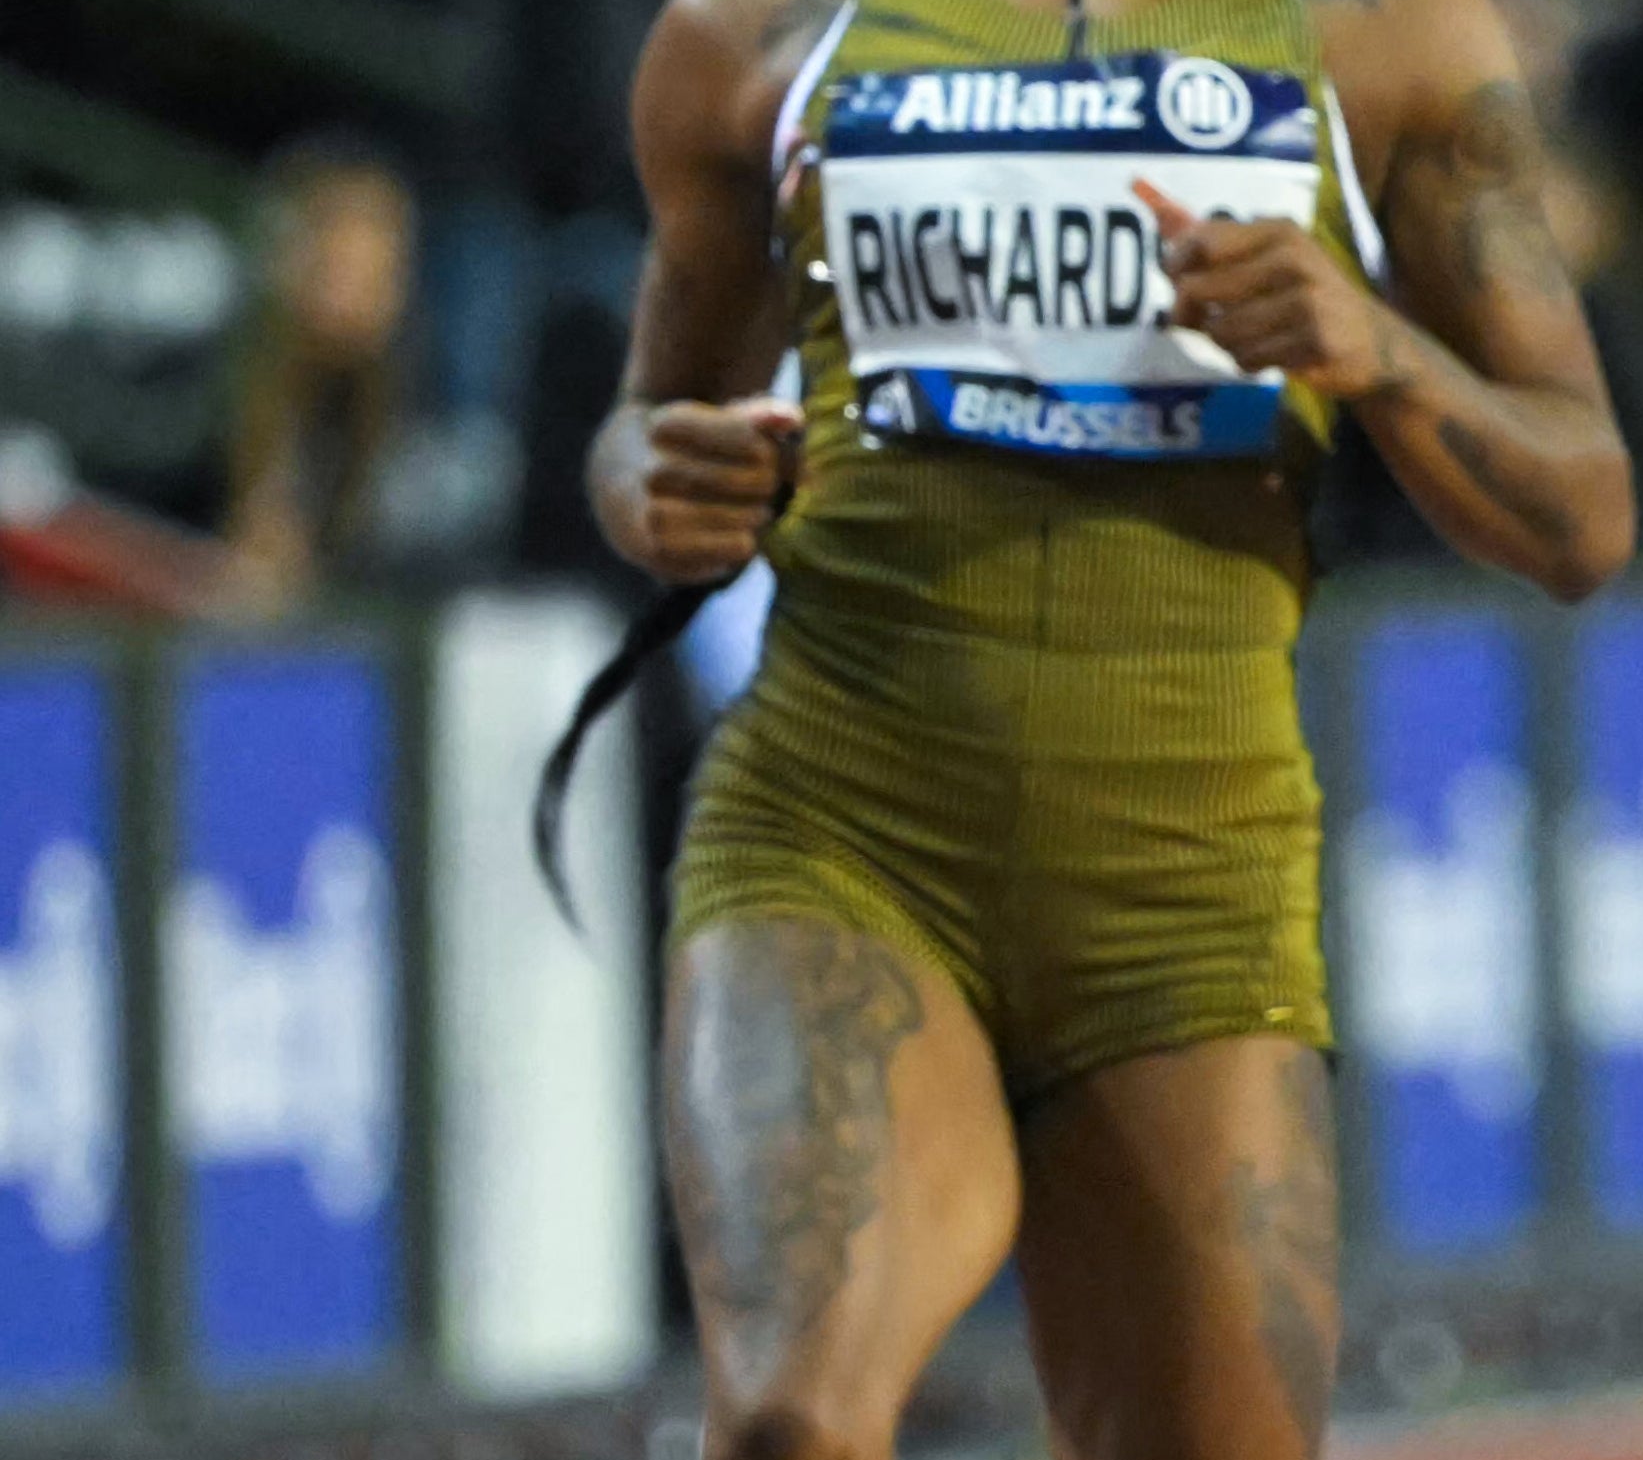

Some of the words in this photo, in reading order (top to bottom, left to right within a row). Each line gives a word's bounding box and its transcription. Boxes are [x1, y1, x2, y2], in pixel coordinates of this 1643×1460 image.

[892, 70, 1146, 134] Allianz
[848, 206, 1242, 329] RICHARD
[948, 383, 1201, 450] BRUSSELS
